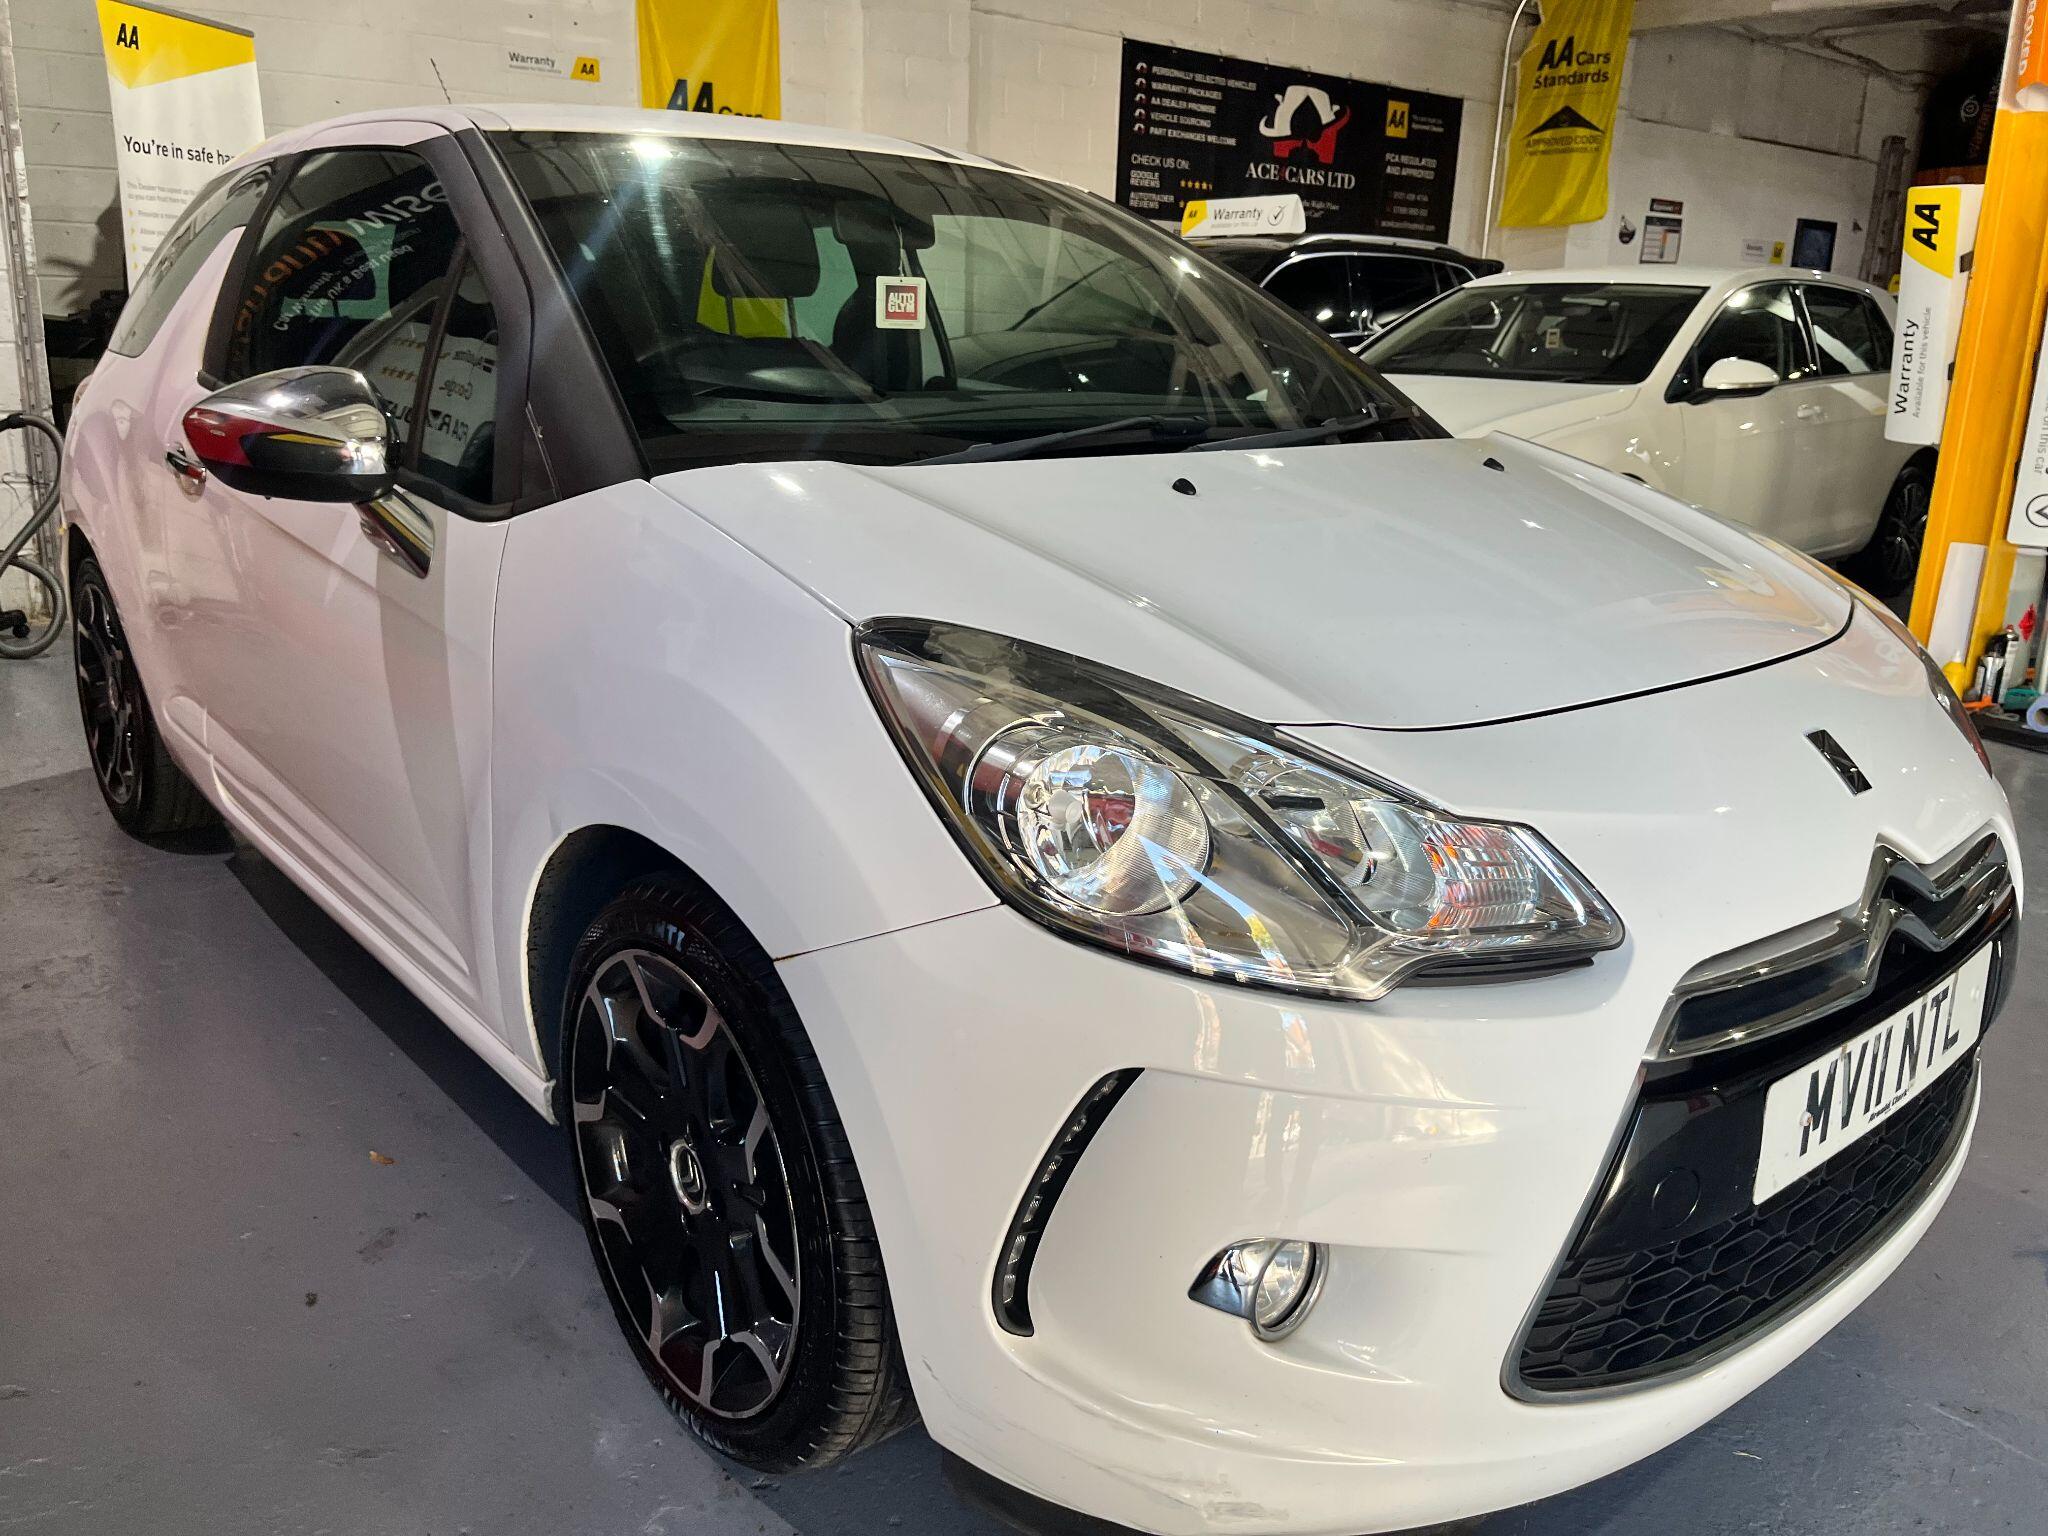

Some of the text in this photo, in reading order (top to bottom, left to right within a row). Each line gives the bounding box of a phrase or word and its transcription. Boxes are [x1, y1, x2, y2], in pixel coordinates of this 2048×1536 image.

[116, 23, 139, 50] AA
[508, 52, 555, 68] Warranty
[1537, 36, 1611, 71] AA Cars
[581, 63, 595, 75] AA
[1533, 69, 1609, 90] Standards
[666, 78, 713, 113] AA
[1388, 109, 1406, 128] AA
[124, 136, 169, 157] You're
[171, 143, 183, 160] in
[187, 147, 214, 164] safe
[1131, 153, 1161, 167] CHECK
[1163, 158, 1175, 168] US
[1327, 171, 1356, 190] LTD
[1213, 208, 1263, 220] Warranty
[1912, 204, 1941, 251] AA
[888, 292, 915, 303] AUTO
[888, 302, 915, 313] GLYM
[1894, 318, 1919, 414] Warranty
[1913, 307, 1932, 418] Available for this vehicle
[2034, 456, 2045, 474] car
[1895, 973, 1960, 1093] NTL
